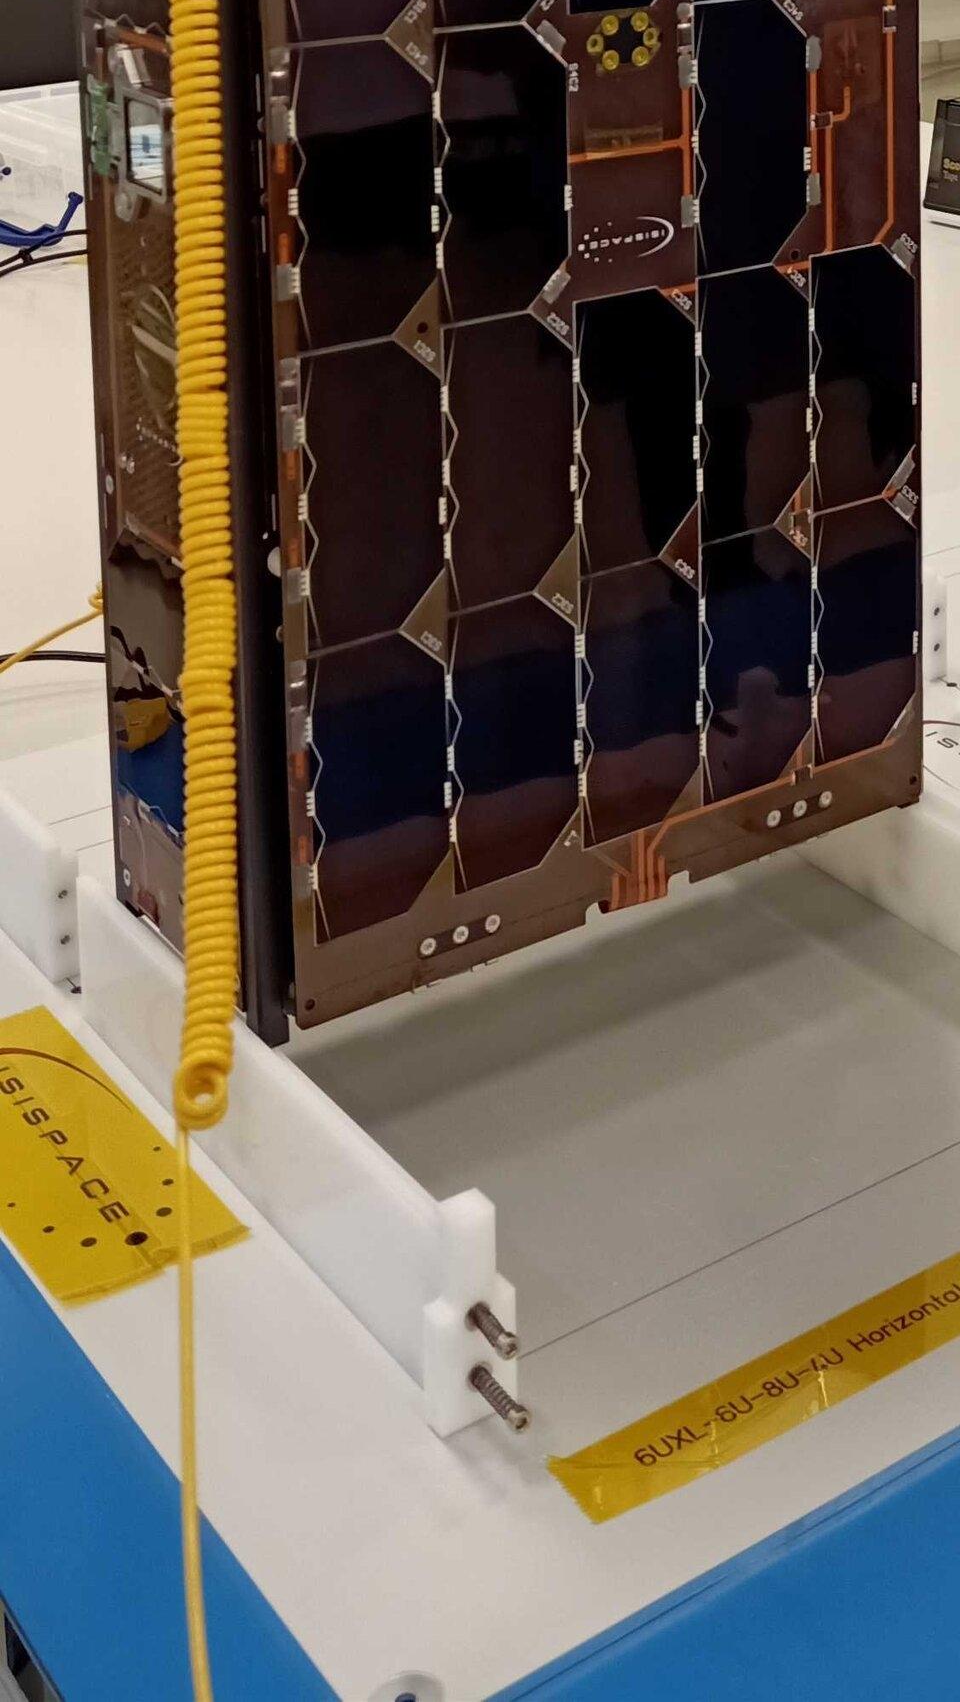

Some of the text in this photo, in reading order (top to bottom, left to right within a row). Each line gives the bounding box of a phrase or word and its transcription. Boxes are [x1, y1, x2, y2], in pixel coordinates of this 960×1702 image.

[568, 63, 579, 92] S4C2
[589, 229, 665, 251] ISISPACE
[547, 312, 569, 336] S2C2
[901, 485, 919, 504] S3C5
[634, 1348, 844, 1467] 6UXL-6U-8U-4U
